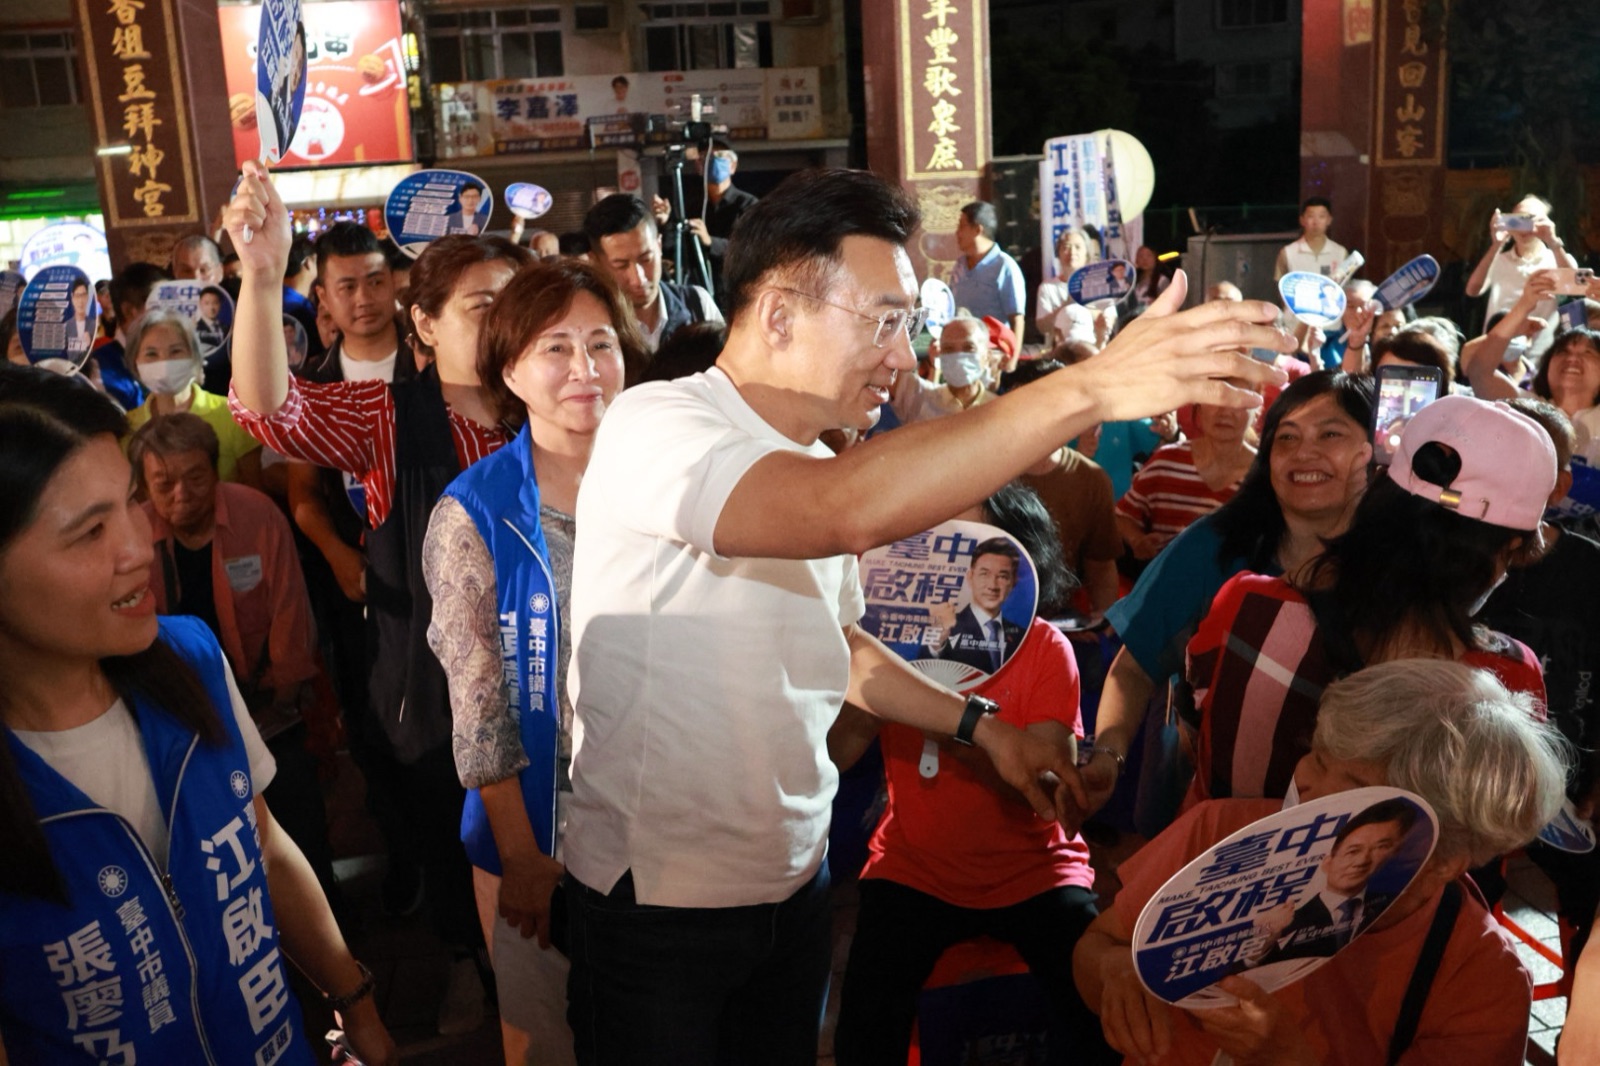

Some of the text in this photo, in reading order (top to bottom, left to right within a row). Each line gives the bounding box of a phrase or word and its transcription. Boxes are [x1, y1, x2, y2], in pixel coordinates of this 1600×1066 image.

[886, 531, 978, 563] 臺中
[889, 560, 925, 570] TAICHUNG
[927, 563, 946, 571] BEST
[948, 565, 968, 574] EVER
[864, 568, 965, 606] 啟程
[878, 622, 943, 647] 江啟臣
[528, 618, 548, 712] 臺中市議員
[1196, 812, 1352, 886] 臺中
[1146, 865, 1319, 944] 啟程
[1157, 853, 1327, 905] MAKE TAICHUNG BEST EVER
[201, 816, 290, 1036] 江啟臣
[115, 896, 177, 1034] 臺中市議員
[1164, 934, 1270, 983] 江啟臣
